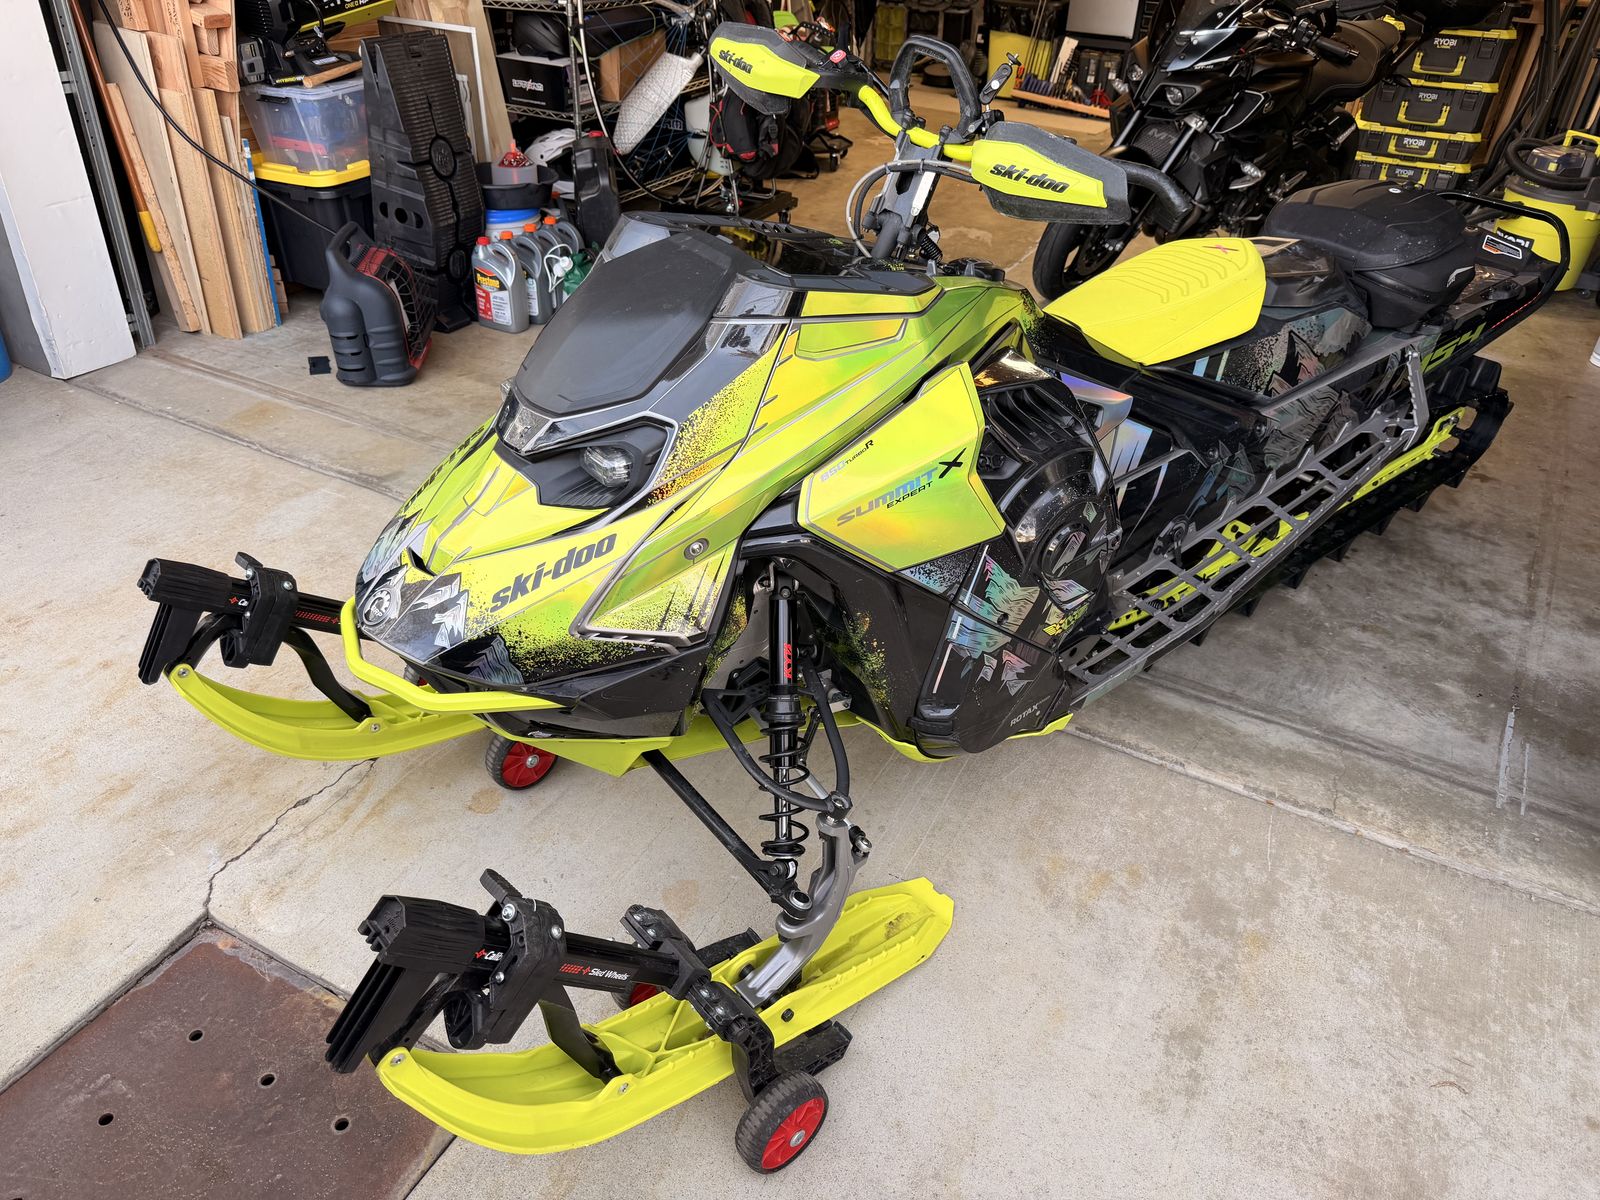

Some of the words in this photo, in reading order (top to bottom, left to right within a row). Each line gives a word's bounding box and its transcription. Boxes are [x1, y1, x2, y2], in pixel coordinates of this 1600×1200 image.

[1433, 37, 1458, 47] RYOBI
[719, 49, 753, 75] ski-doo
[1418, 92, 1439, 100] RYOBI
[1402, 137, 1426, 147] RYOBI
[989, 163, 1070, 194] ski-doo
[476, 273, 500, 289] Prestone
[836, 466, 938, 526] SUMMIT
[886, 480, 933, 509] EXPERT
[489, 533, 617, 613] ski-doo
[1009, 702, 1039, 727] ROTAX
[588, 967, 606, 977] Sled
[605, 969, 631, 981] Wheels
